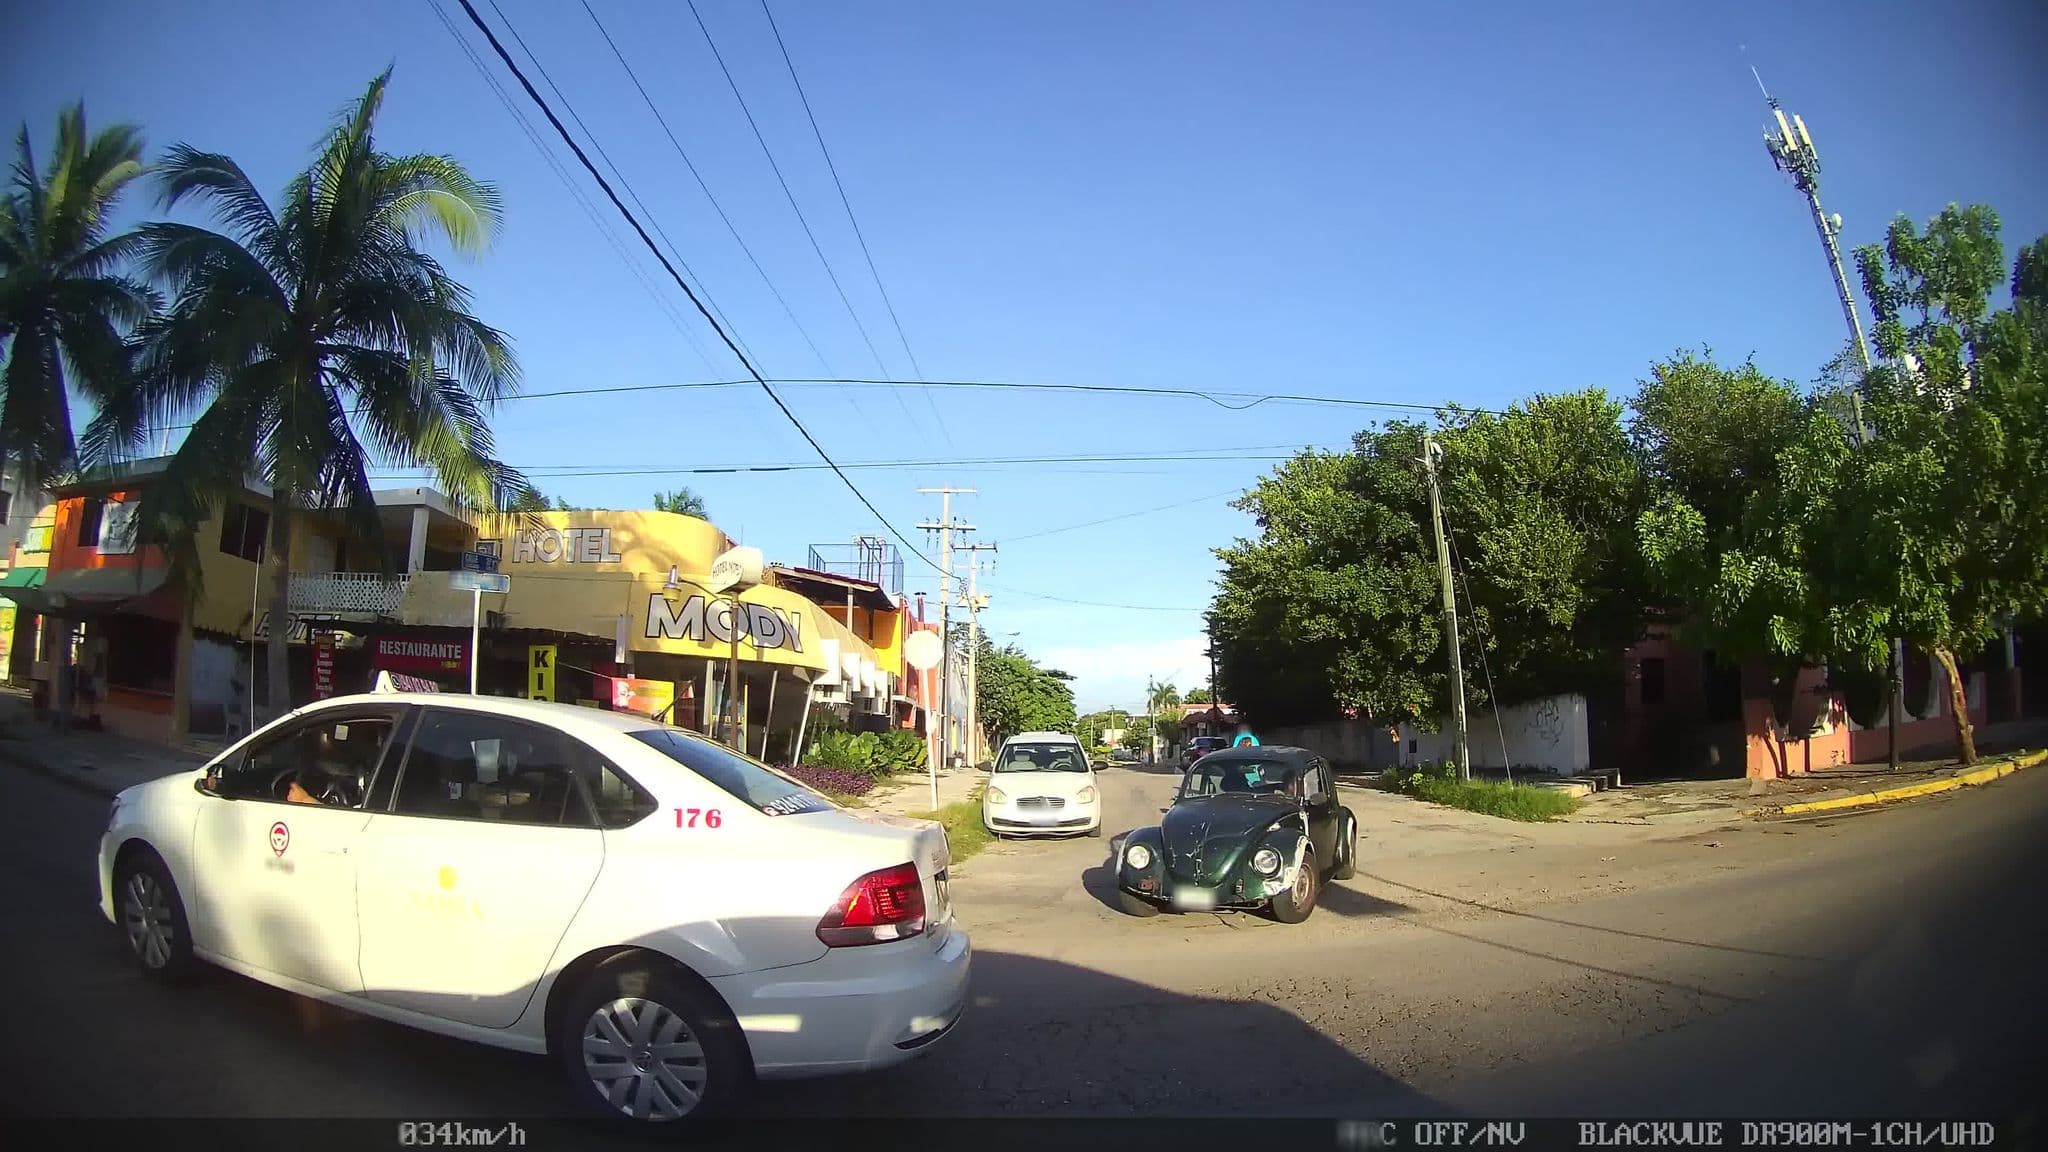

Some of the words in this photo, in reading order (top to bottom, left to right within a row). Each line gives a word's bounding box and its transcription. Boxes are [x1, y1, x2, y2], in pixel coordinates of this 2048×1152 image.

[512, 528, 622, 563] HOTEL
[645, 592, 804, 653] MODY
[379, 639, 462, 659] RESTAURANTE
[533, 650, 550, 701] KI
[674, 808, 722, 828] 176
